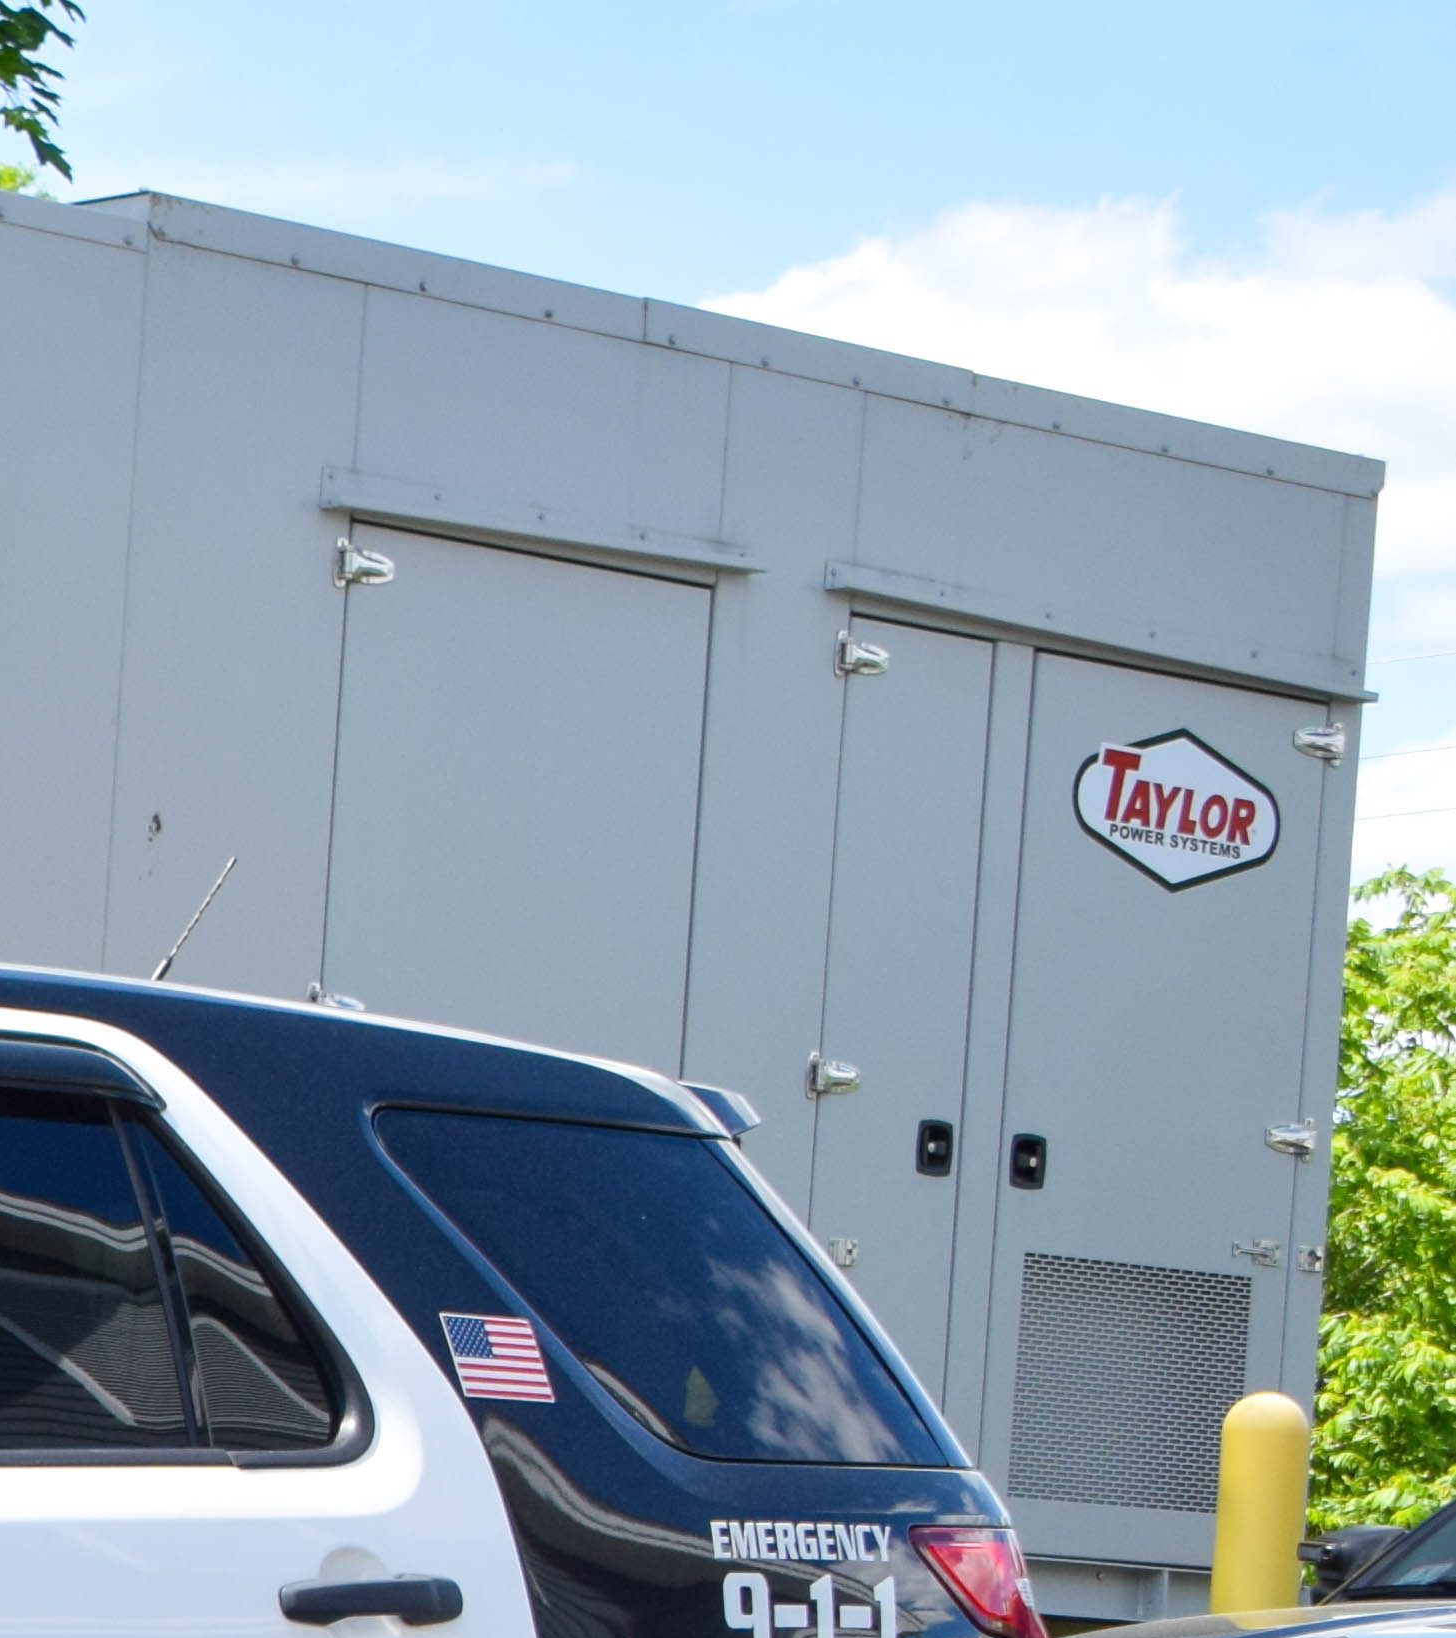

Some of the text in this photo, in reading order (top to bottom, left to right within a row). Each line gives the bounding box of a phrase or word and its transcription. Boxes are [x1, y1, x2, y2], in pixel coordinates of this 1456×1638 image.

[1102, 748, 1256, 846] TAYLOR
[1109, 824, 1242, 860] POWER SYSTEMS
[710, 1519, 891, 1562] EMERGENCY
